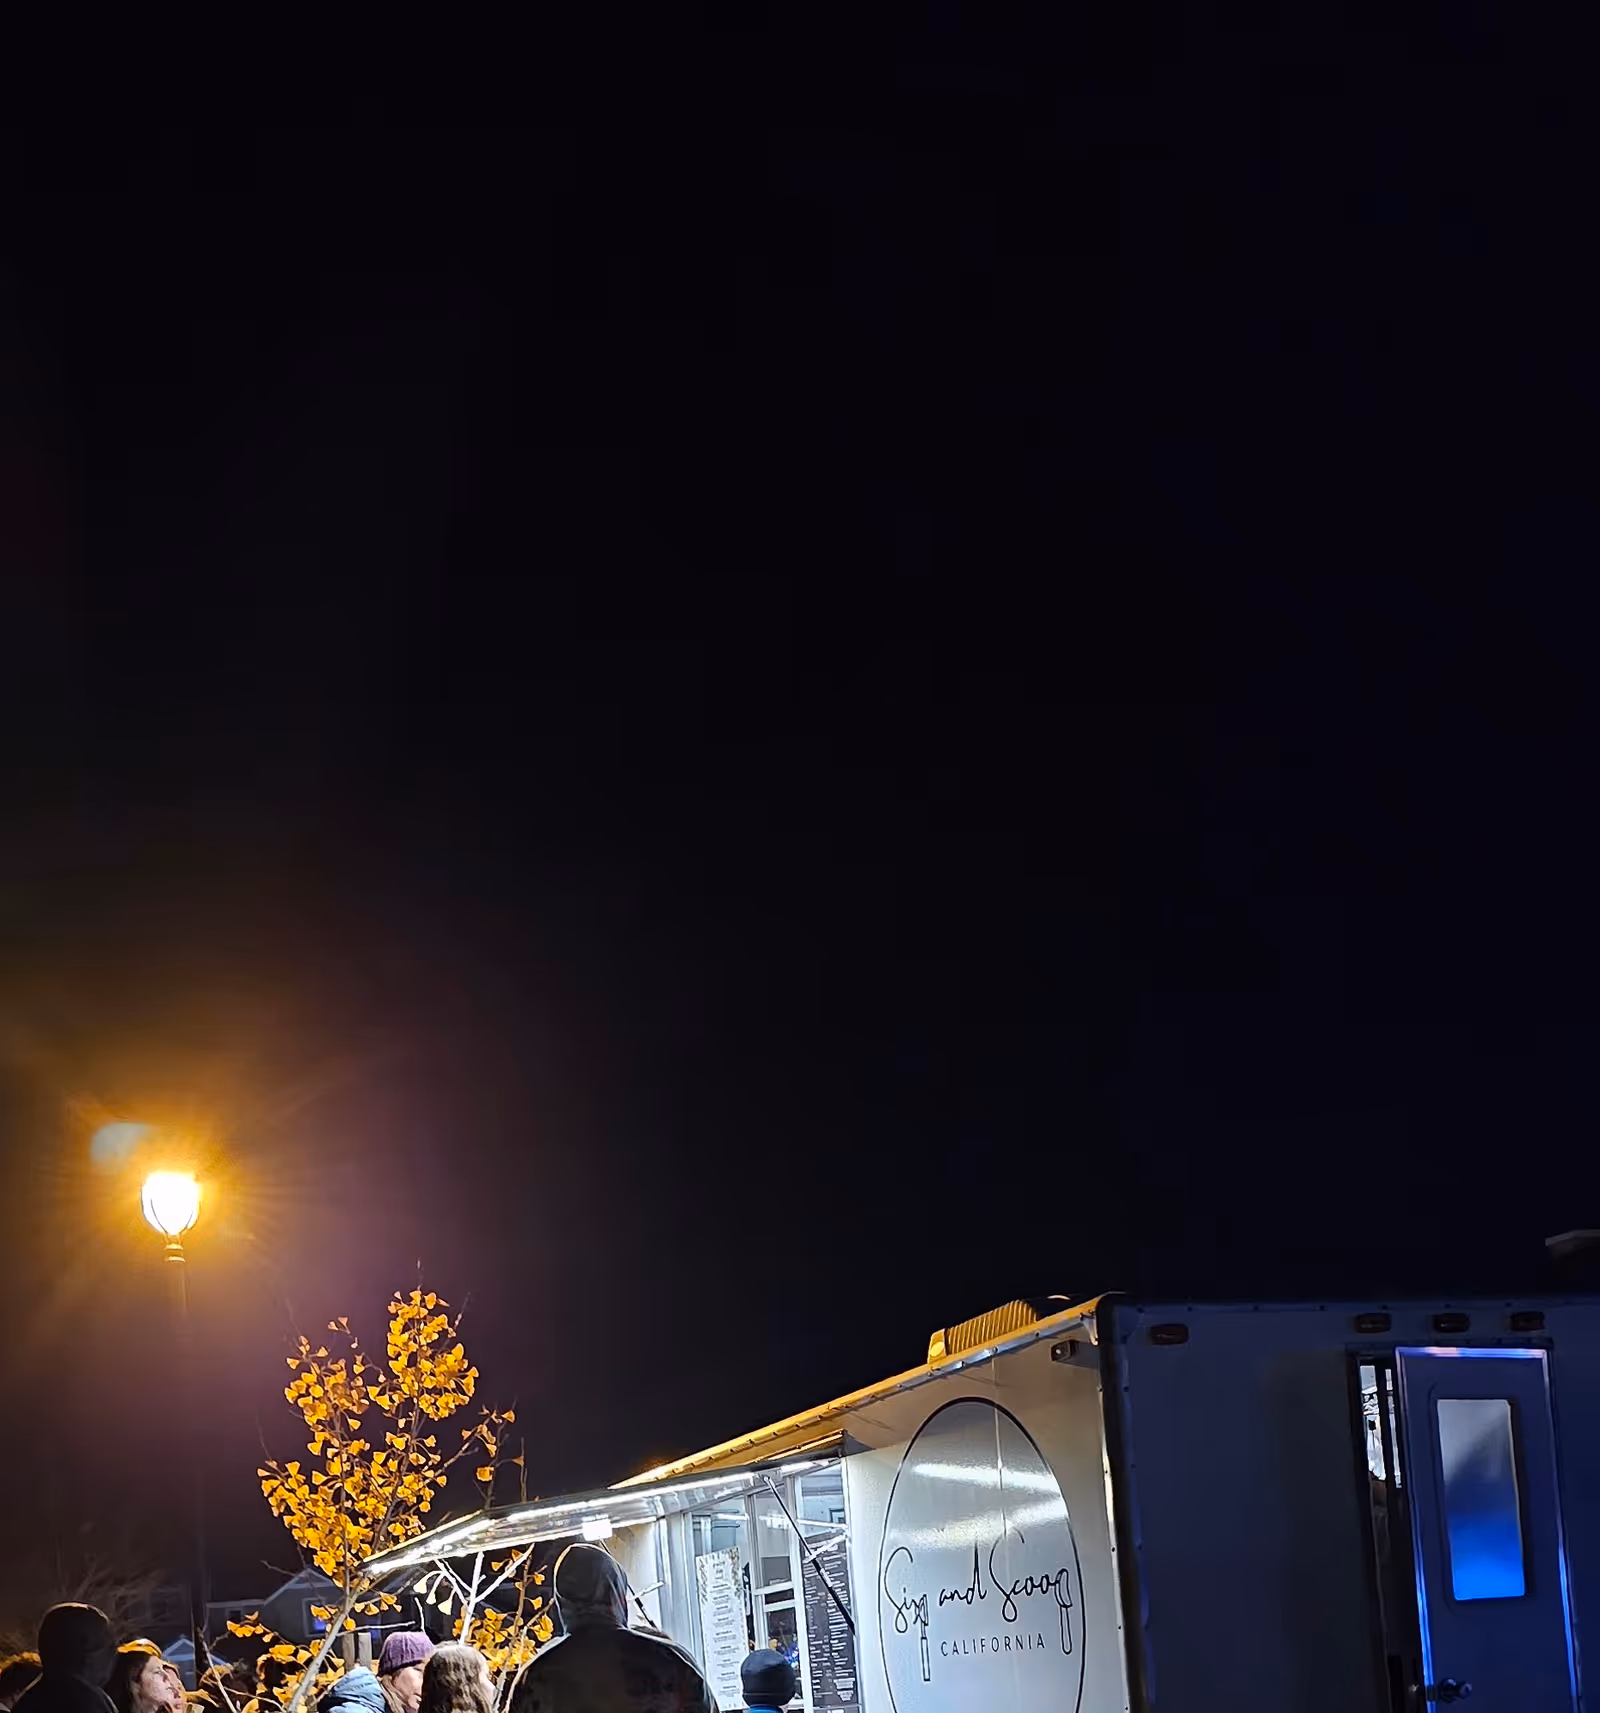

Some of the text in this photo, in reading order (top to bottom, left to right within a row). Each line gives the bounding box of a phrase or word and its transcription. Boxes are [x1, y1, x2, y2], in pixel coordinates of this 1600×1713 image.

[939, 1541, 987, 1606] and
[989, 1527, 1073, 1655] Scoop
[941, 1633, 1046, 1657] CALIFORNIA
